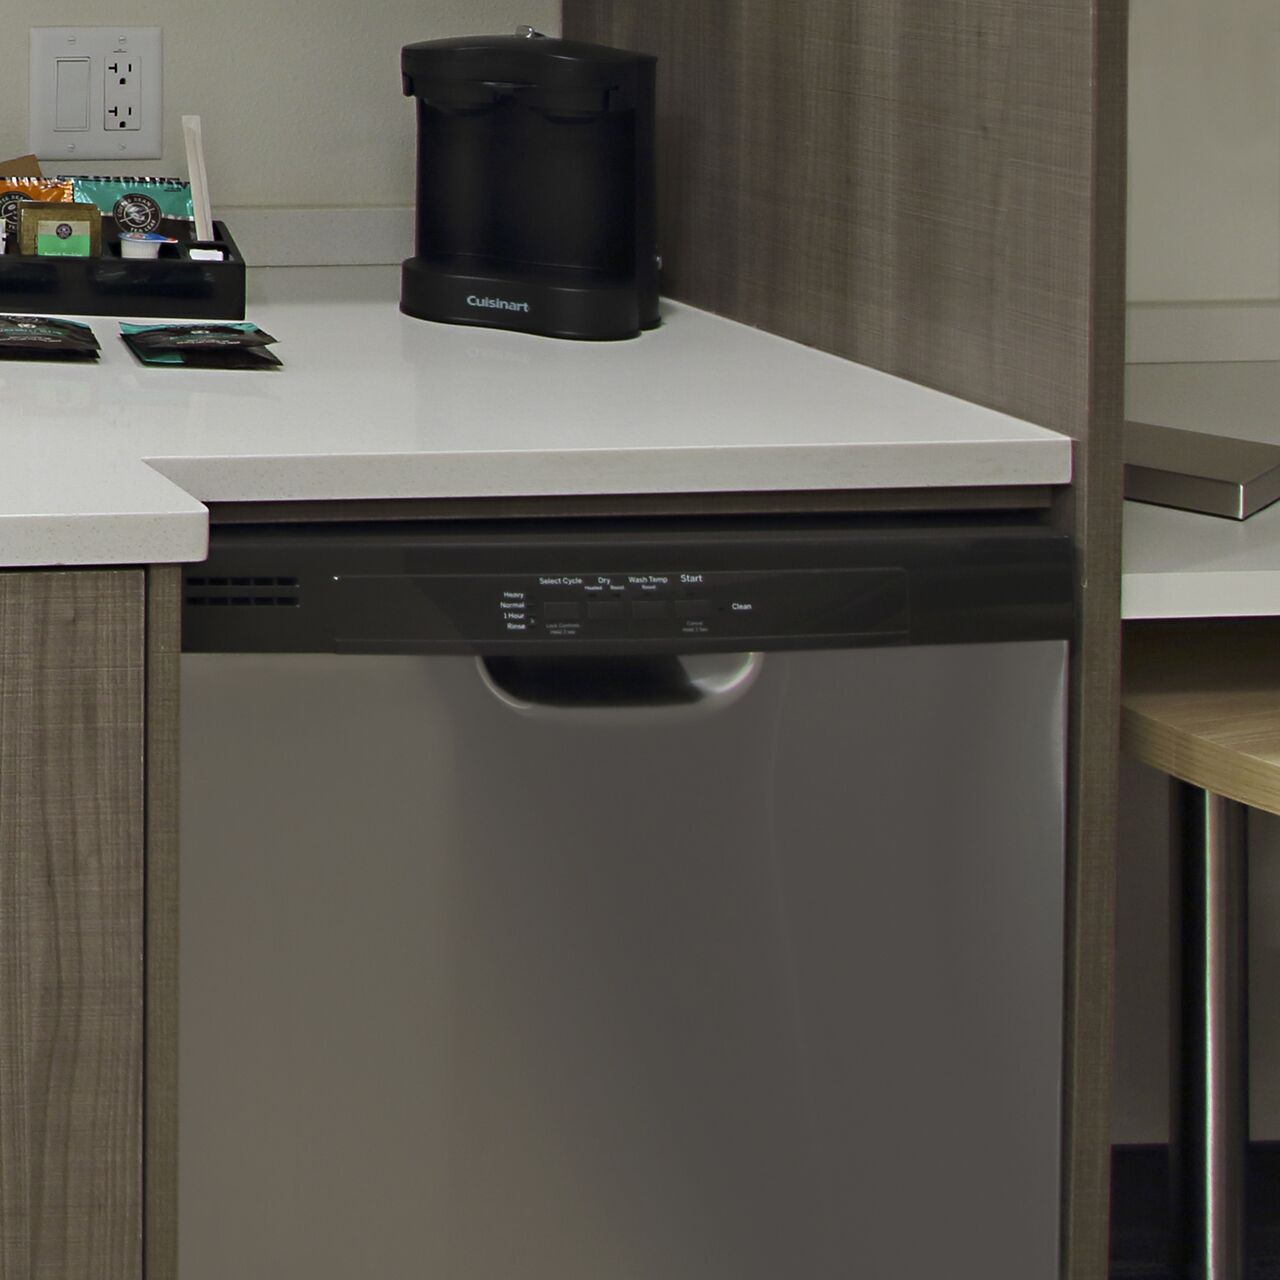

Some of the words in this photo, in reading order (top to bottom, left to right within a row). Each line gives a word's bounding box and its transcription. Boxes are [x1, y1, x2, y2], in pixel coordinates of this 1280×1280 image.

[466, 295, 529, 313] Cuisinart
[538, 577, 562, 585] Select
[562, 576, 583, 586] Cycle
[597, 576, 611, 585] Dry
[628, 576, 648, 584] Wash
[648, 576, 668, 585] Temp
[680, 573, 703, 583] Start
[503, 592, 524, 600] Heavy
[731, 602, 752, 610] Clean
[506, 622, 526, 630] Rinse
